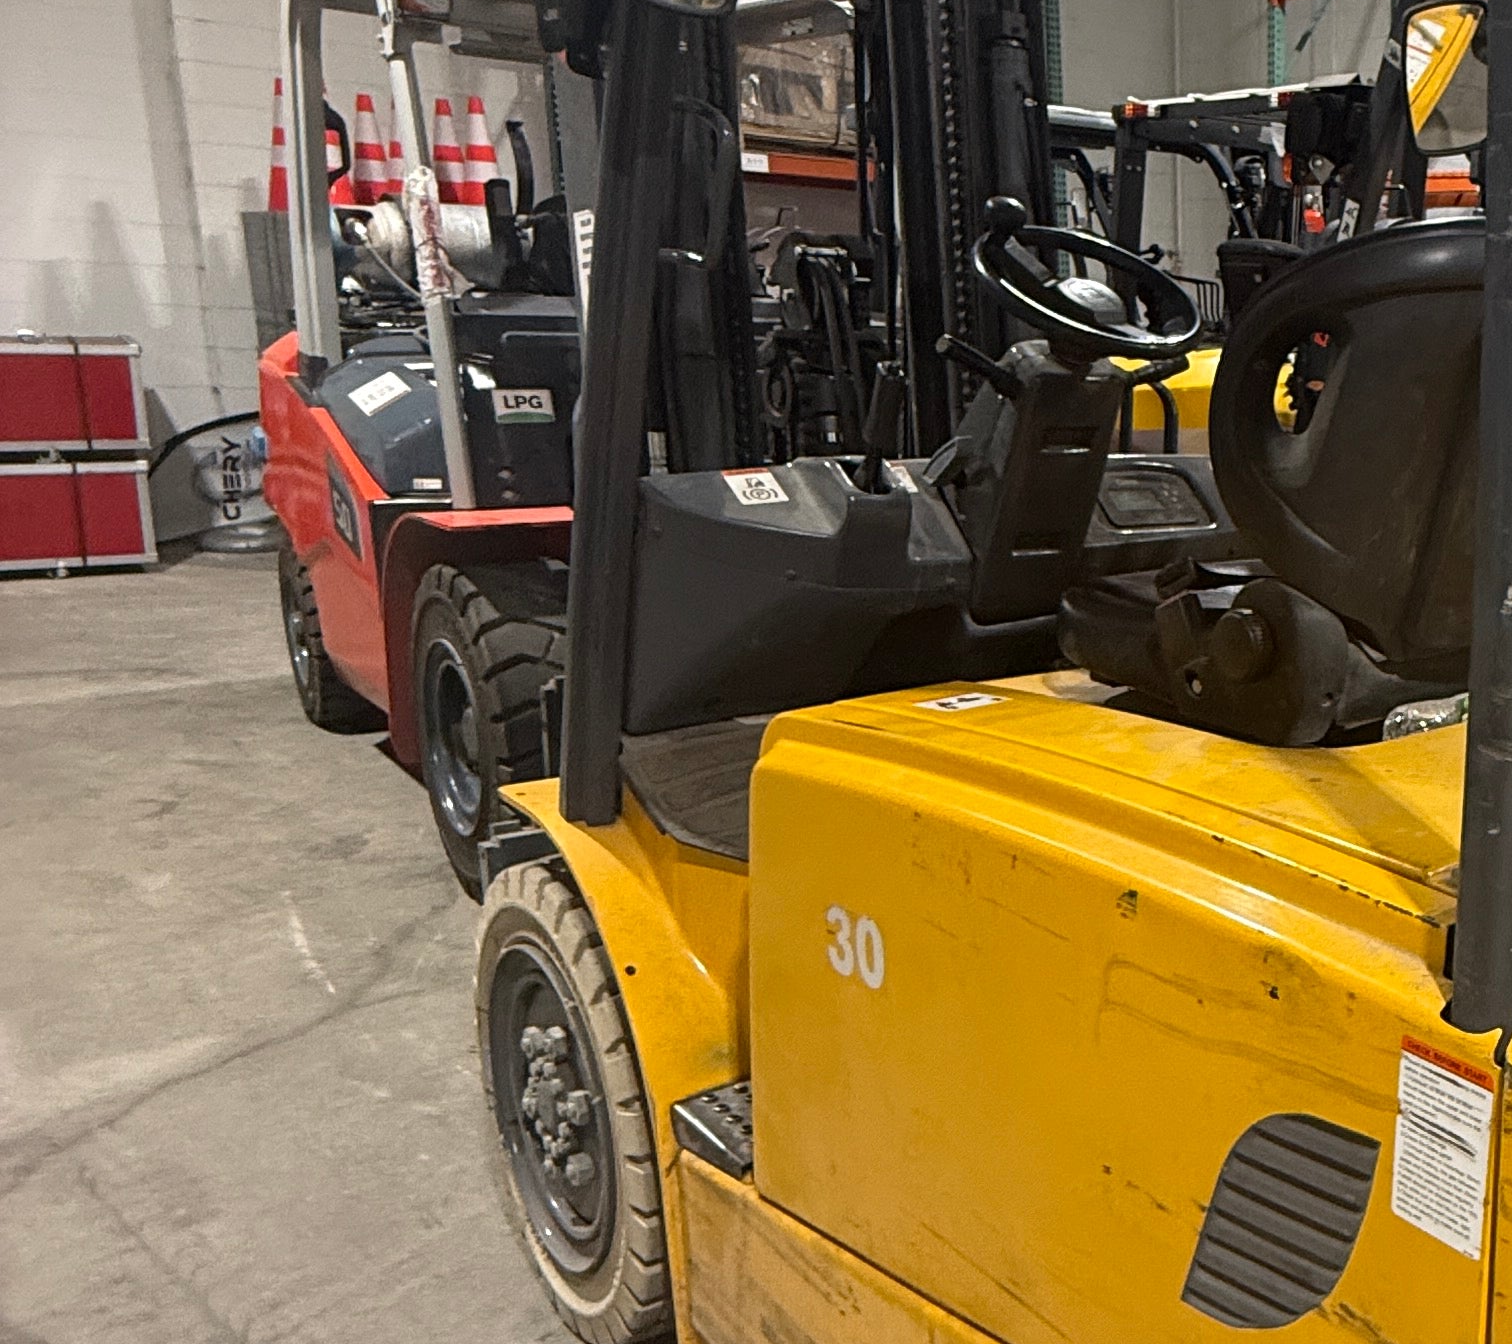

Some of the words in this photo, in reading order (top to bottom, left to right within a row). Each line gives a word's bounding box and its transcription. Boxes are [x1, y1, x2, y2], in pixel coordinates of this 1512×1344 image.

[503, 395, 543, 409] LPG
[222, 436, 242, 520] CHERY
[826, 904, 885, 989] 30
